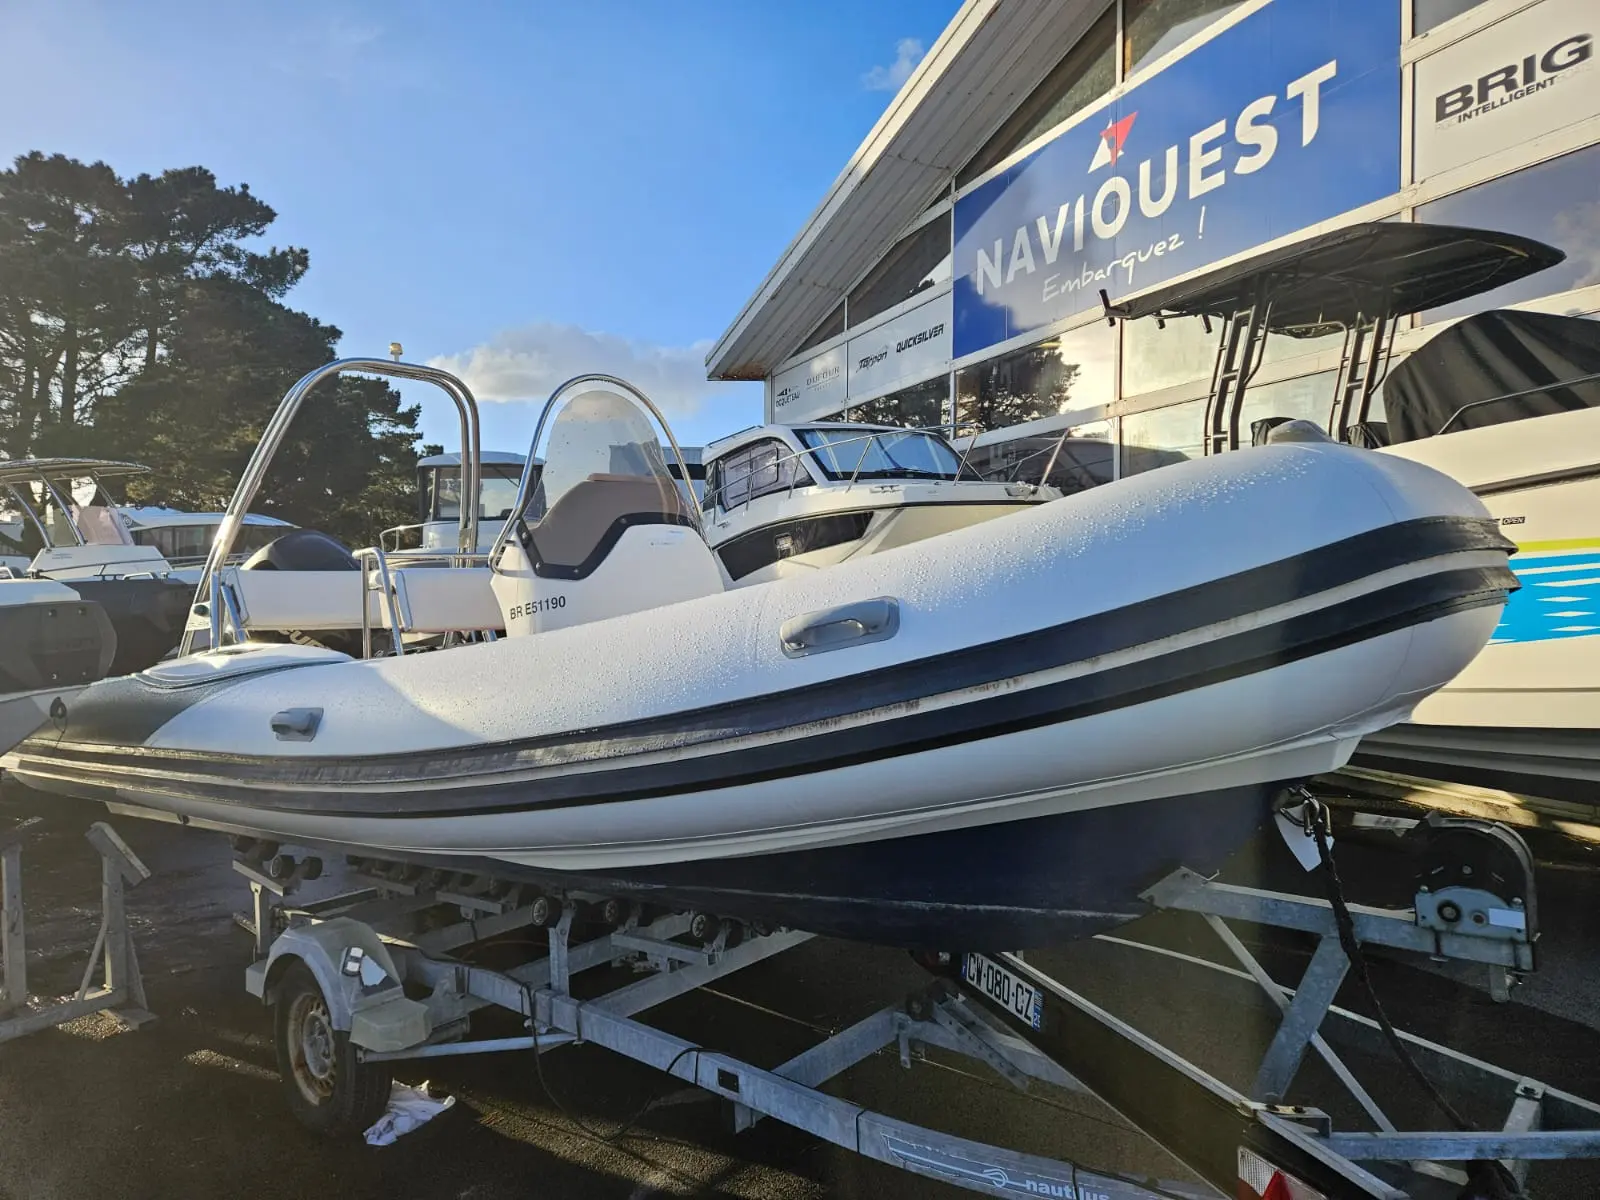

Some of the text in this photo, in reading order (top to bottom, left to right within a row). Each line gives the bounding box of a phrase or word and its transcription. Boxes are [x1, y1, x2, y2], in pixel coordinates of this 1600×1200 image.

[1435, 33, 1594, 123] BRIG
[1457, 75, 1558, 123] INTELLIGENT
[976, 59, 1337, 295] NAVIOUEST
[1042, 233, 1185, 302] Embarquez
[896, 323, 945, 353] QUICKSILVER
[1502, 516, 1525, 525] OPEN
[510, 595, 566, 620] BR E51190
